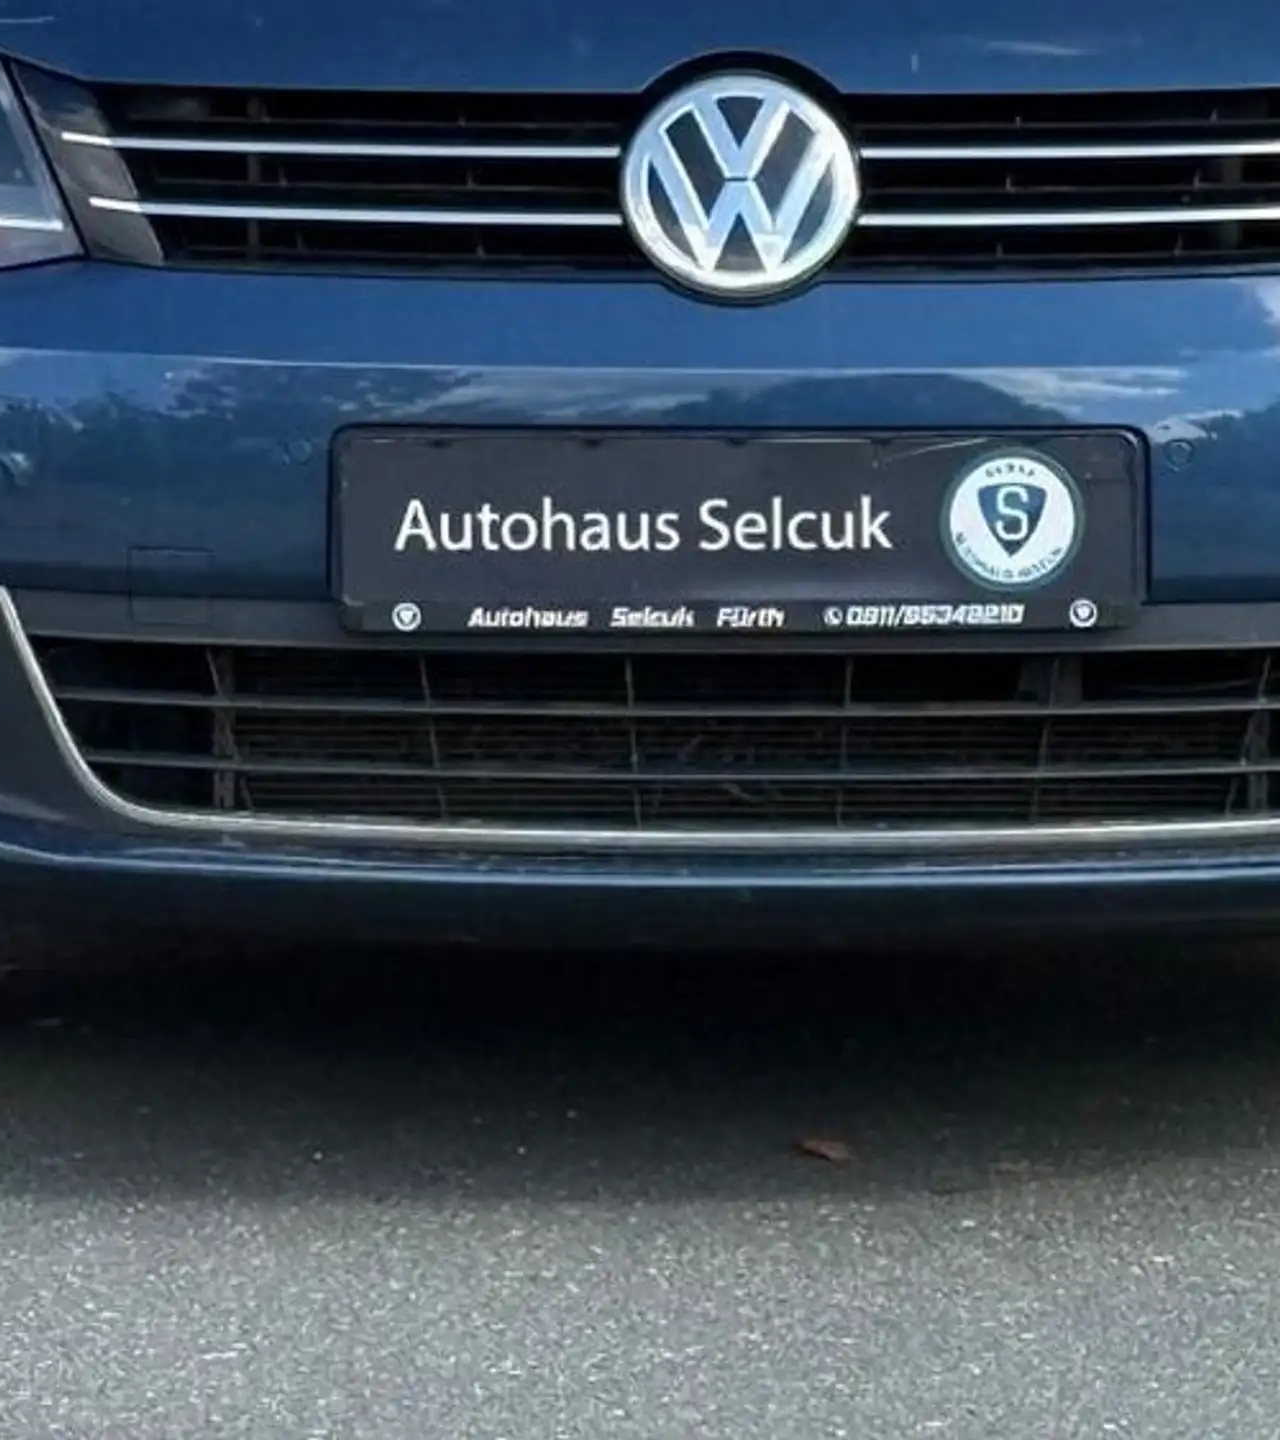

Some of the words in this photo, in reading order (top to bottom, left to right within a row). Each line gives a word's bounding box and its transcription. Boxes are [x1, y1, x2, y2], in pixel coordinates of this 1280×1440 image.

[393, 497, 681, 553] Autohaus
[699, 493, 893, 552] Selcuk
[995, 485, 1029, 541] S
[467, 606, 590, 629] Autohaus
[717, 605, 784, 629] Fürth
